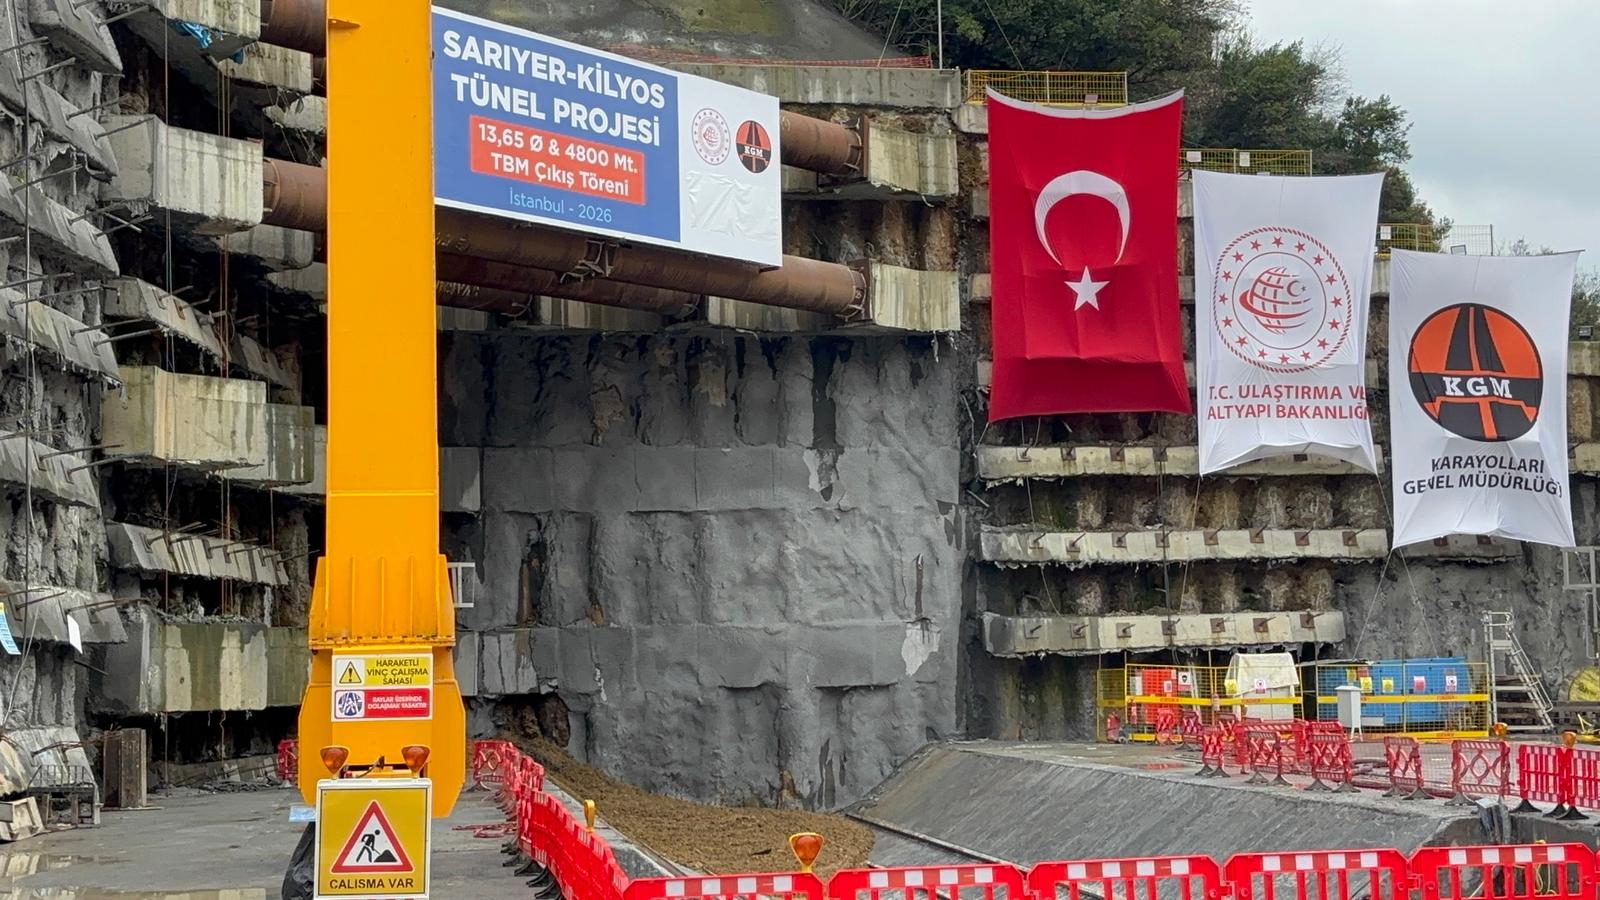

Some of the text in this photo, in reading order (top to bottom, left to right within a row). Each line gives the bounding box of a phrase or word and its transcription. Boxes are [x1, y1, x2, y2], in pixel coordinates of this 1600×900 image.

[443, 30, 665, 109] SARIYER-KİLYOS
[451, 72, 660, 147] TÜNEL PROJESİ
[479, 123, 524, 149] 13,65
[548, 138, 560, 157] &
[564, 143, 609, 167] 4800
[614, 152, 639, 174] Mt.
[744, 145, 764, 158] KGM
[490, 152, 630, 197] TBM Çıkış Töreni
[509, 187, 565, 215] İstanbul
[578, 203, 613, 224] 2026
[1209, 385, 1233, 400] T.C.
[1238, 384, 1343, 403] ULAŞTIRMA
[1442, 376, 1513, 399] KGM
[1207, 404, 1271, 420] ALTYAPI
[1431, 455, 1545, 474] KARAYOLLARI
[388, 878, 414, 888] VAR
